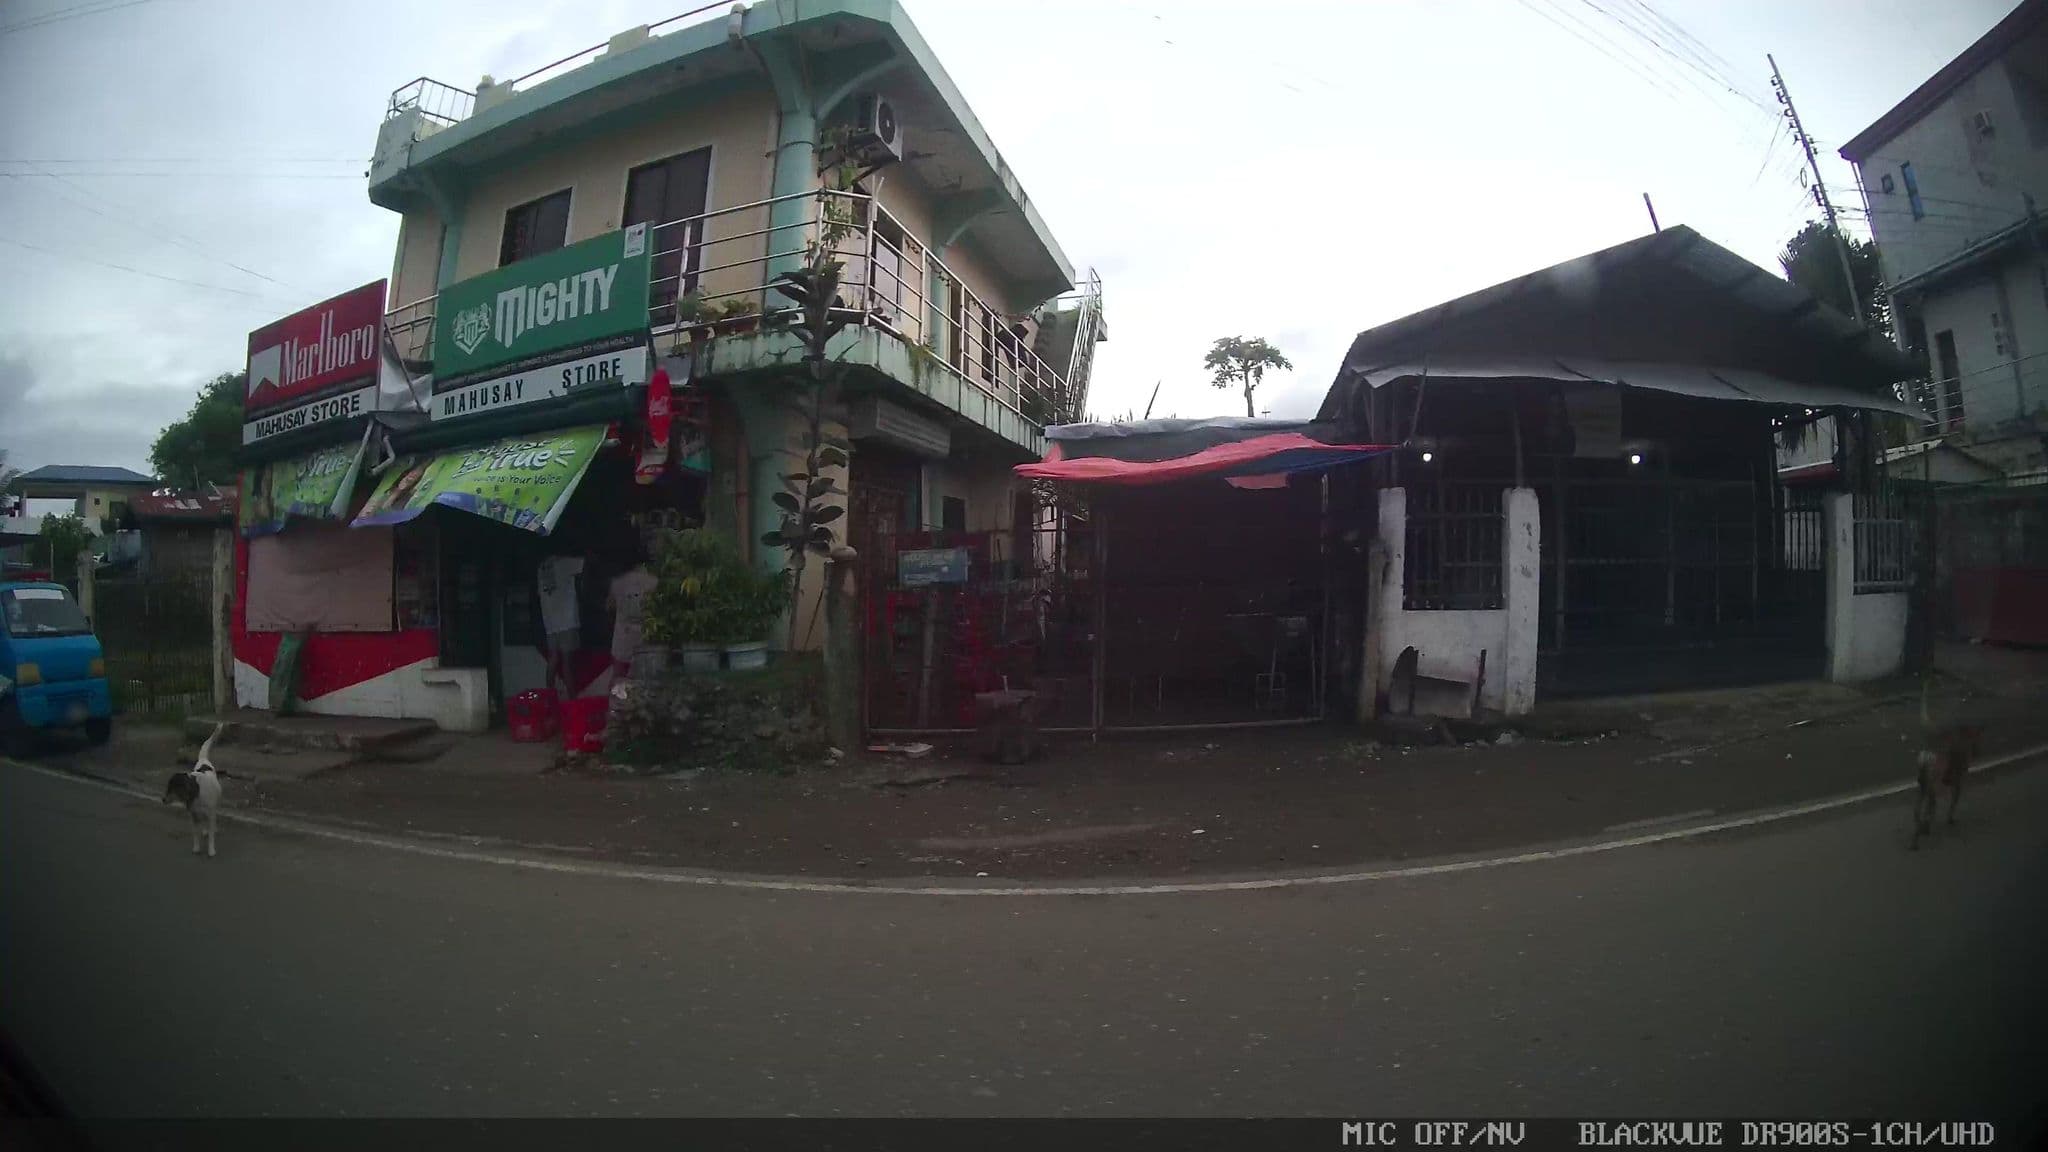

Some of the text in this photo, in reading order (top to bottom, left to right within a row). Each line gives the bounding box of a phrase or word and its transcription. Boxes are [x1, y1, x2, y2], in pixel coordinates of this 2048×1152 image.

[494, 263, 619, 348] MIGHTY
[284, 309, 375, 386] Marlboro
[255, 407, 309, 439] MAHUSAY
[311, 393, 361, 422] STORE
[444, 378, 524, 416] MAHUSAY
[562, 357, 621, 389] STORE
